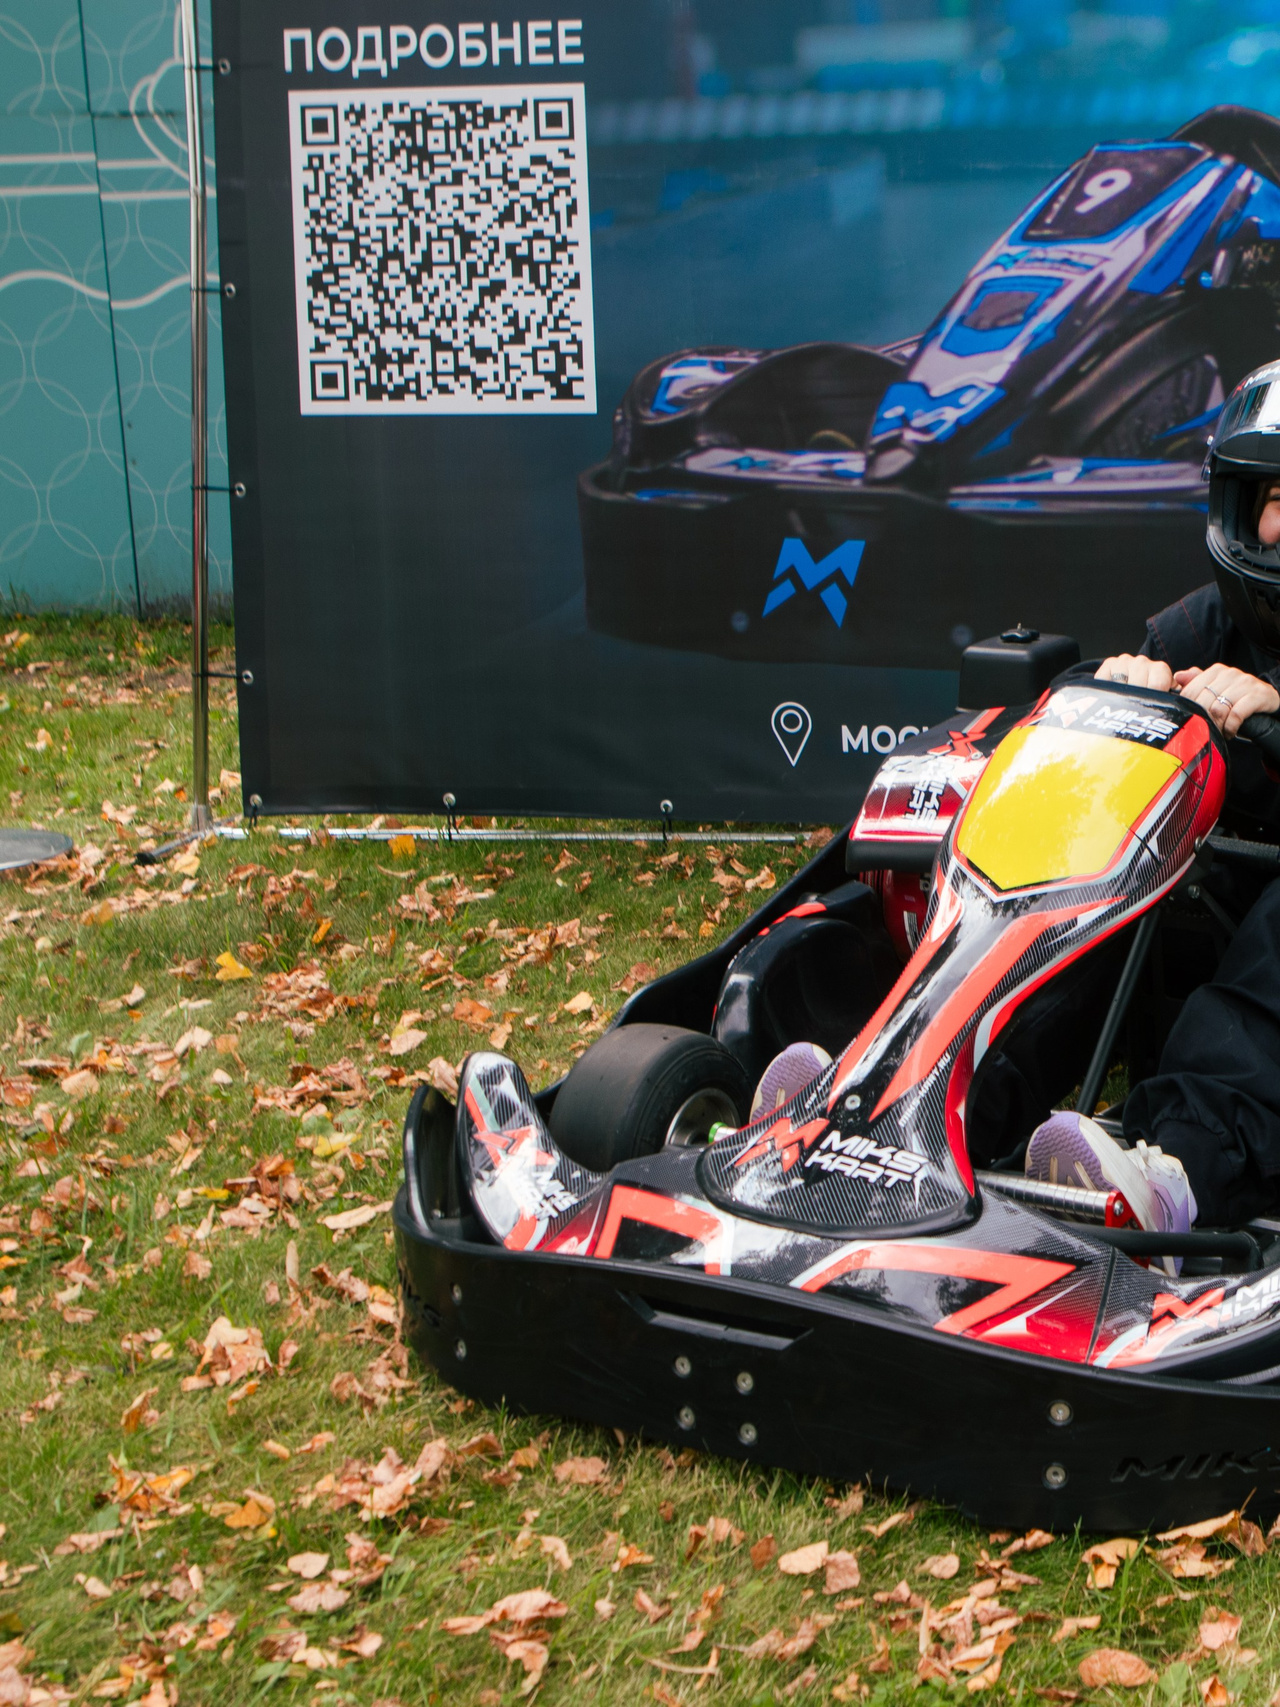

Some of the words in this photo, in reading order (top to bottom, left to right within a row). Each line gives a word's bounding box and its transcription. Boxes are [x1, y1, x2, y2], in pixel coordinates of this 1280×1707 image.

[283, 19, 585, 79] ПОДРОБНЕЕ
[1074, 168, 1132, 214] 9
[1083, 716, 1167, 743] KART
[1094, 705, 1180, 735] MIKS
[804, 1150, 912, 1189] KART
[819, 1130, 929, 1174] MIKS
